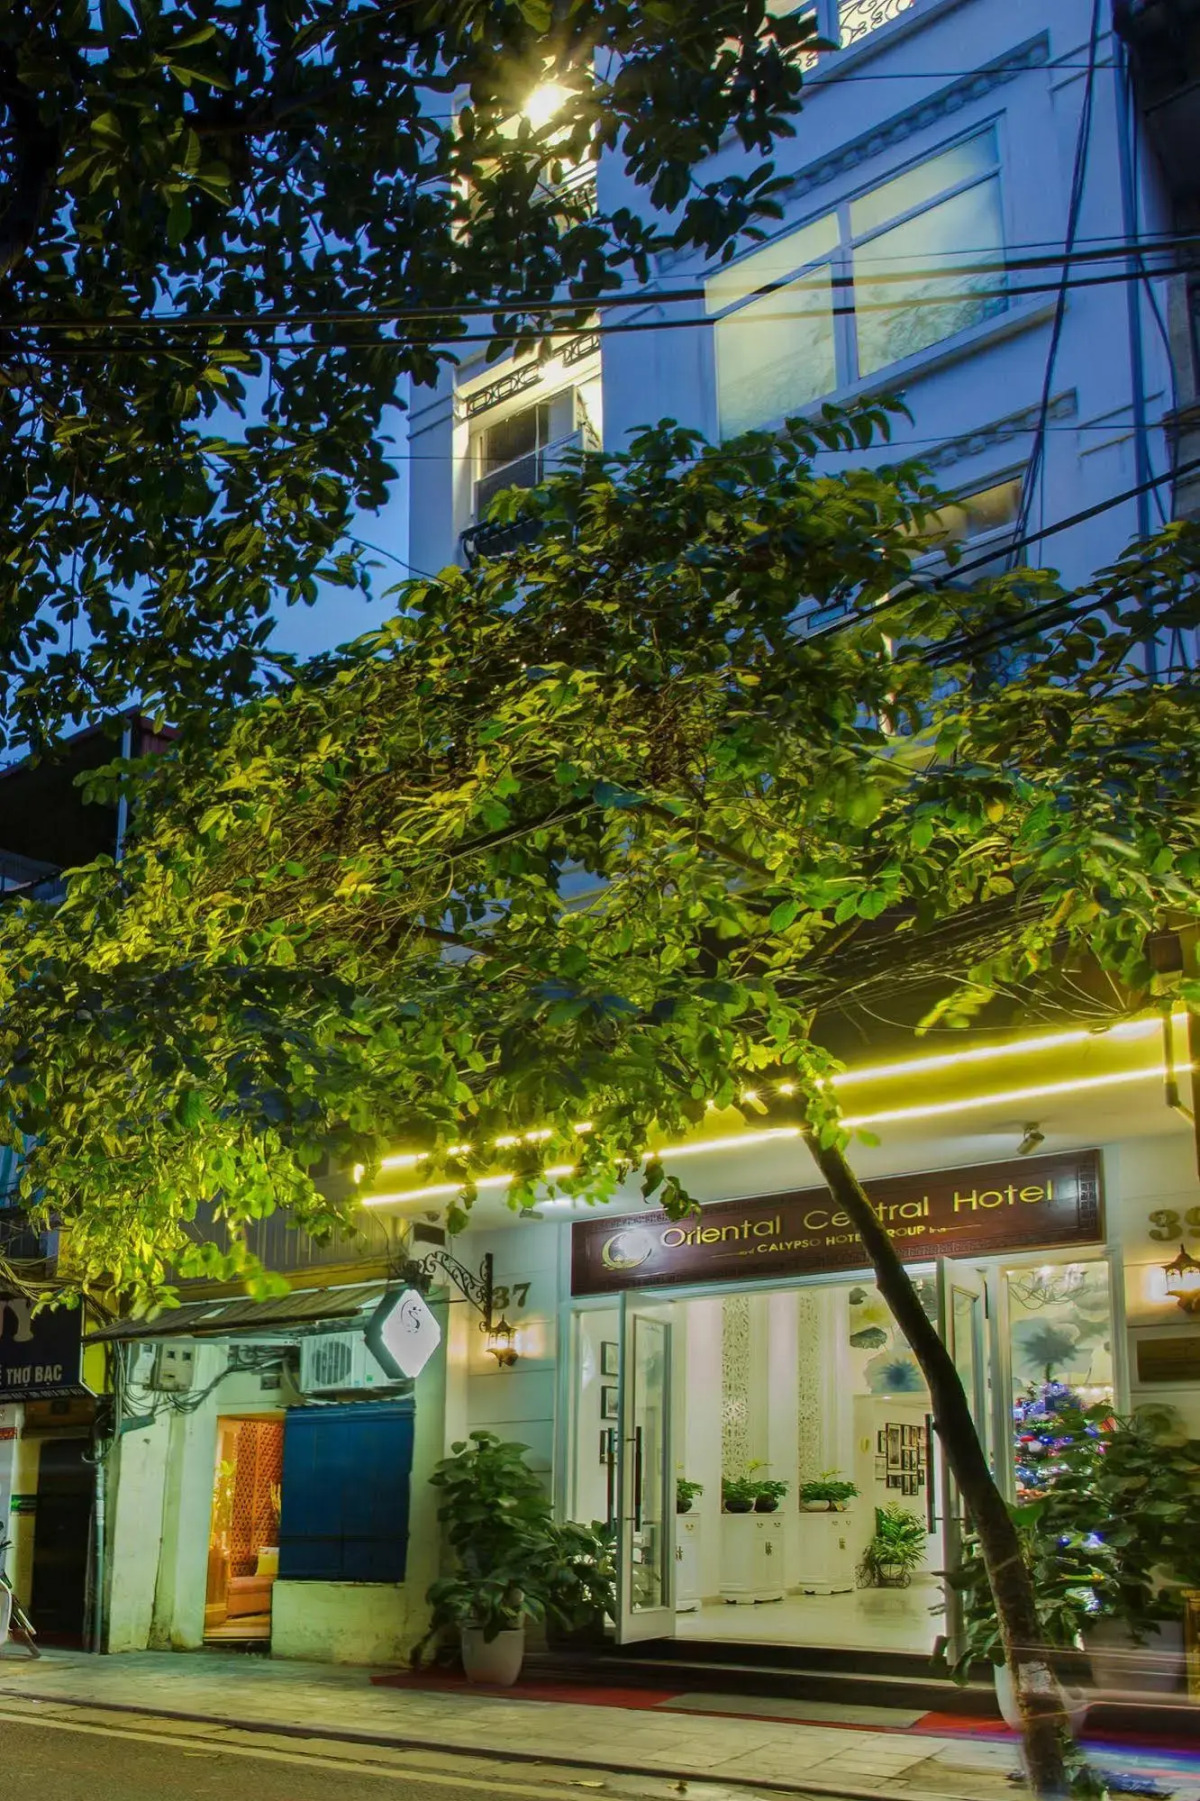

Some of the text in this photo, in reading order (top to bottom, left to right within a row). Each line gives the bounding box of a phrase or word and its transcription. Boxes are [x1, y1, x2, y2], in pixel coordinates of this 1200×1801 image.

[661, 1180, 1052, 1248] Oriental Cetral Hotel
[757, 1225, 925, 1253] CALYPSO HOTE ROUP
[492, 1281, 532, 1310] 37
[6, 1365, 31, 1387] THỢ
[34, 1364, 63, 1386] BẠC
